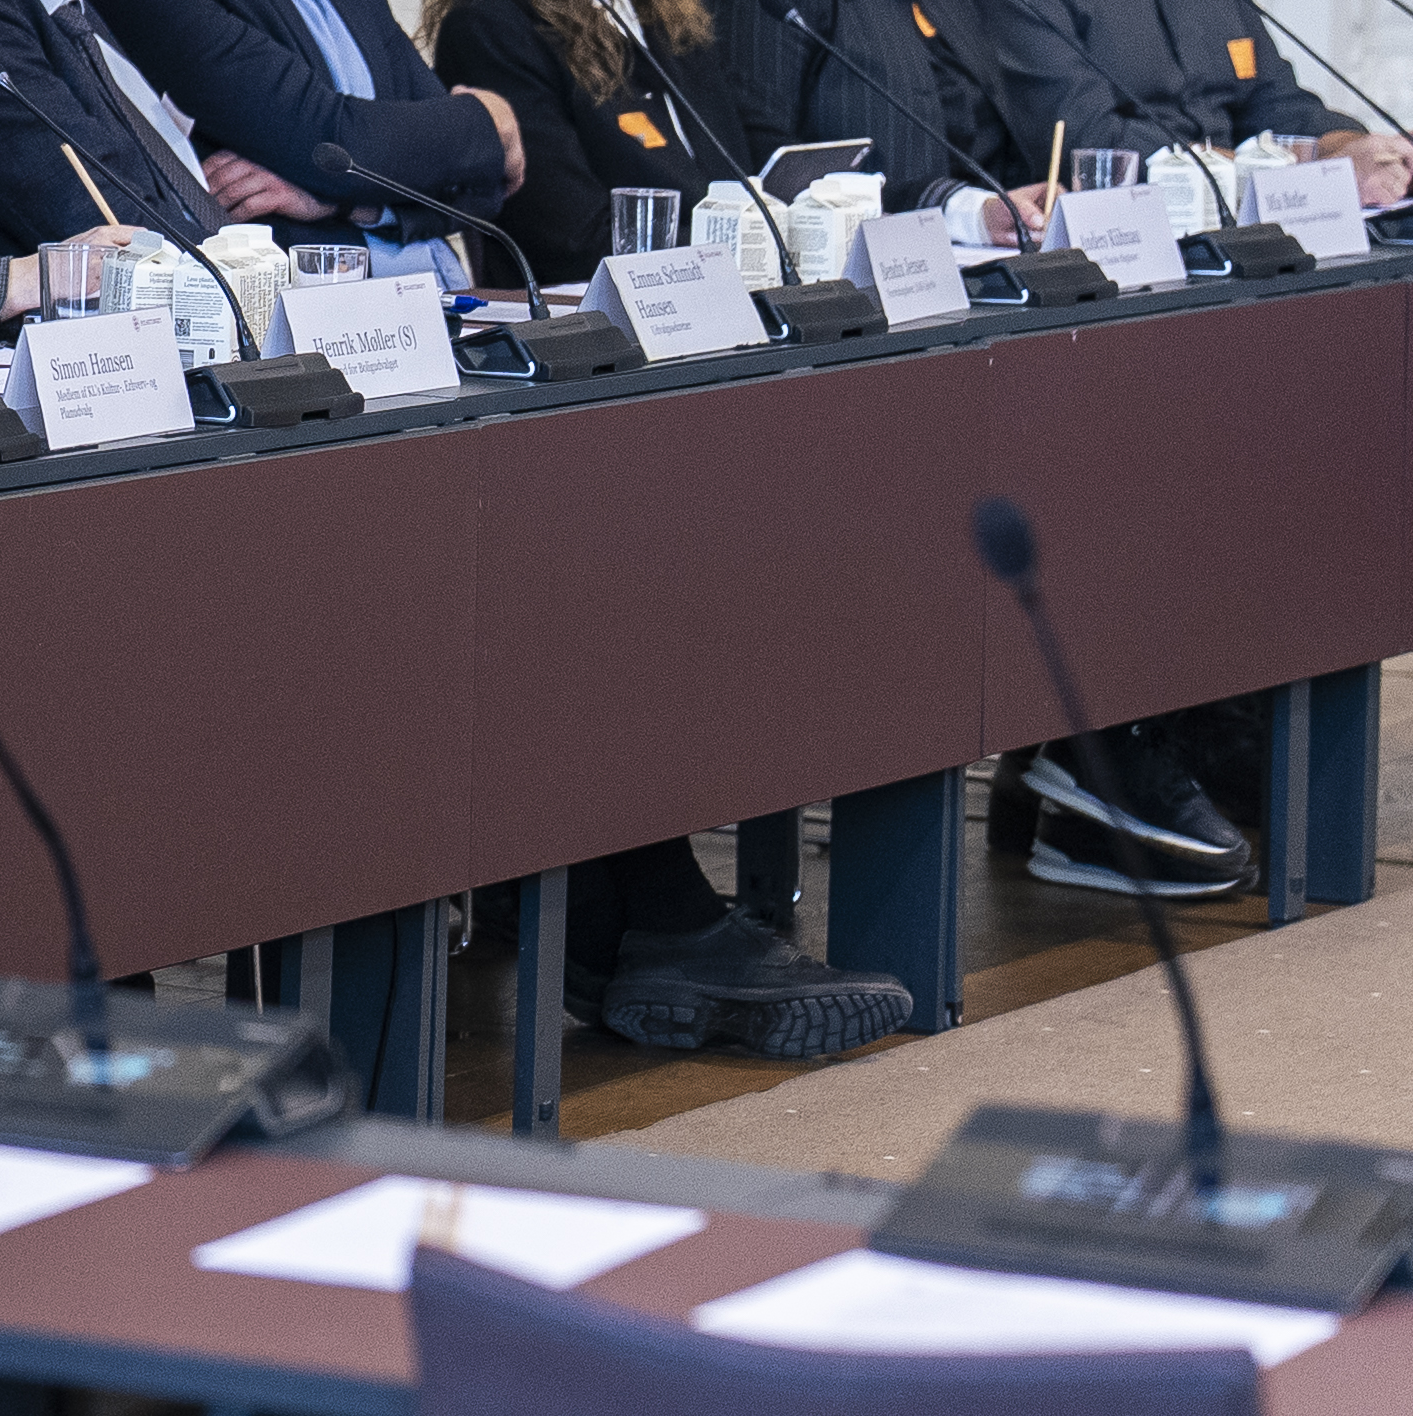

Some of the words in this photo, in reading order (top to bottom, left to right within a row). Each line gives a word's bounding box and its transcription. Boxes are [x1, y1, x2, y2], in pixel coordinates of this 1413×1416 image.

[627, 270, 664, 290] Emma
[661, 261, 705, 285] Schmidt
[635, 300, 678, 319] Hansen
[313, 332, 358, 358] Henrik
[398, 324, 417, 351] (S)
[50, 357, 89, 381] Simon
[88, 353, 134, 375] Hansen
